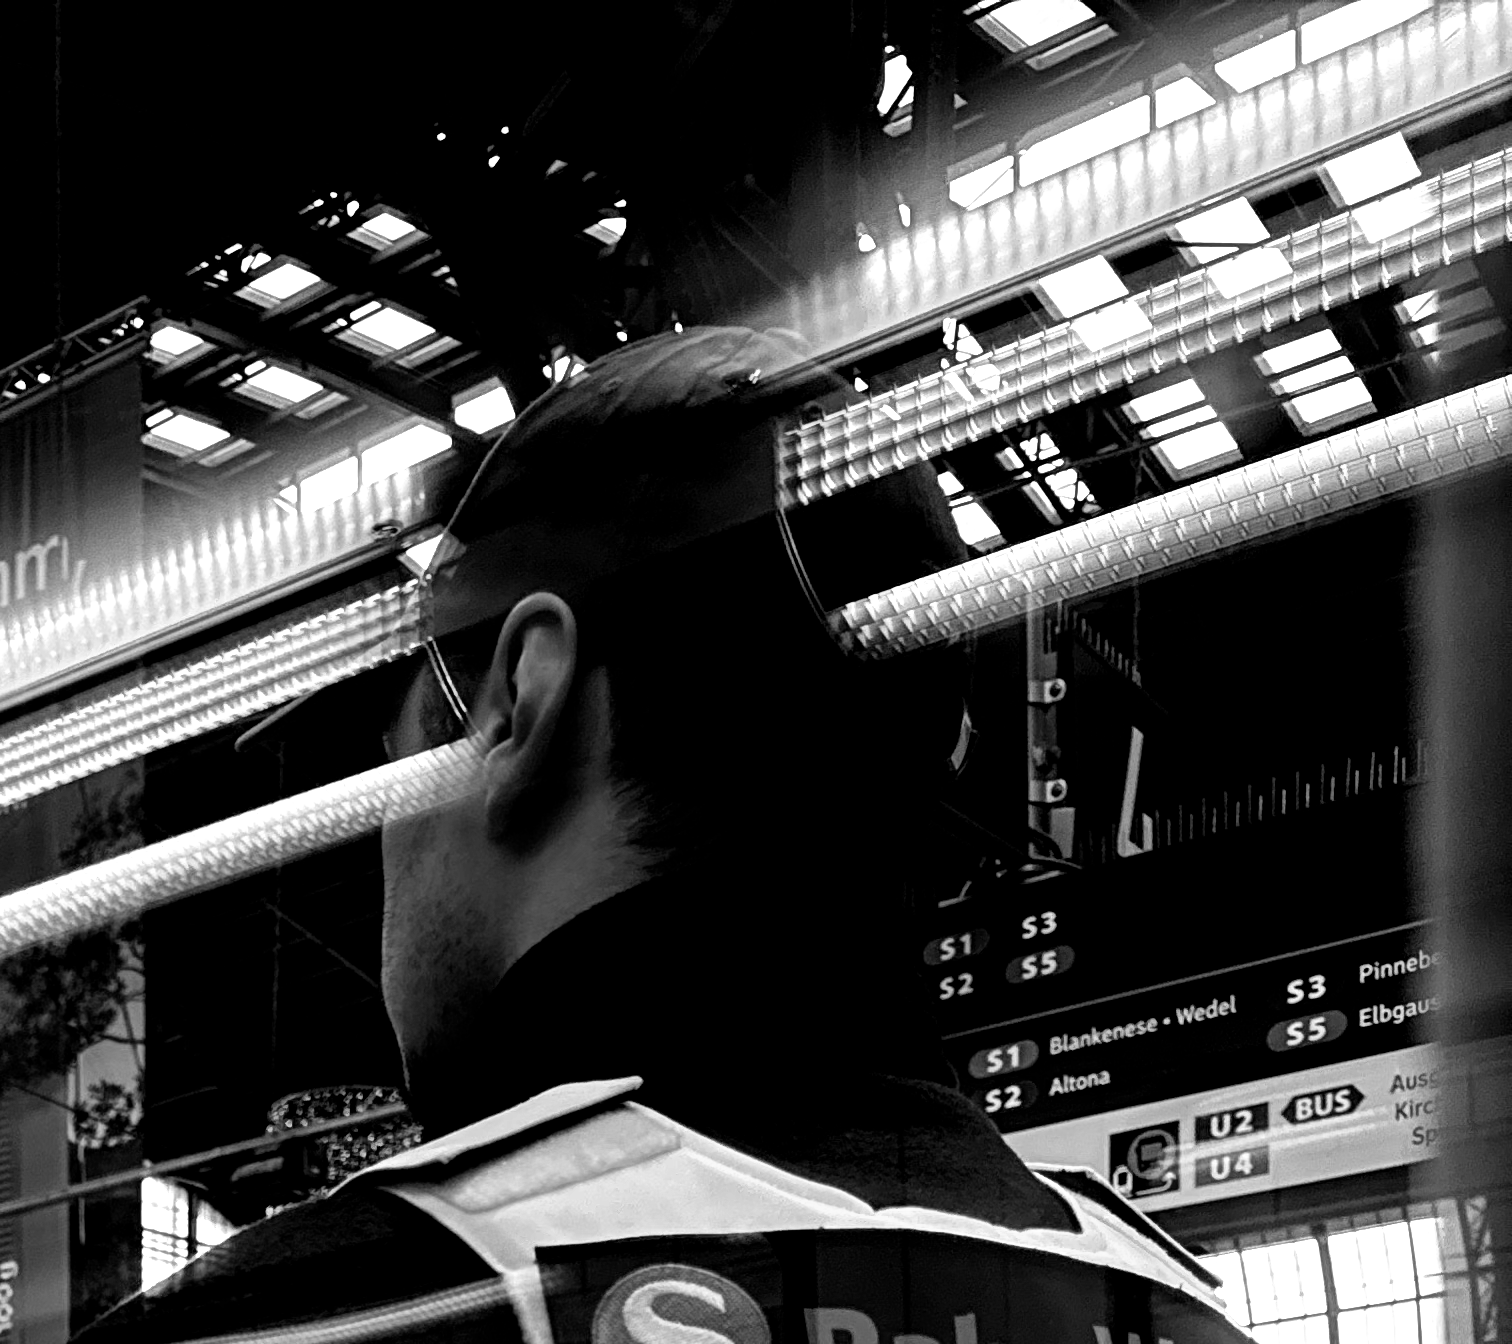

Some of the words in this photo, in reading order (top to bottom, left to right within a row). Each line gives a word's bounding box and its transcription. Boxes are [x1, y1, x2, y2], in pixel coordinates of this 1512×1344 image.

[939, 932, 973, 962] S1
[1021, 910, 1058, 940] S3
[939, 971, 975, 1002] S2
[1021, 949, 1058, 980] S5
[1286, 974, 1327, 1005] S3
[986, 1045, 1020, 1074] S1
[1049, 1017, 1158, 1057] Blankenese
[1175, 994, 1237, 1026] Wedel
[1286, 1015, 1327, 1047] S5
[985, 1085, 1022, 1113] S2
[1048, 1070, 1111, 1098] Altona
[1209, 1111, 1255, 1139] U2
[1294, 1090, 1352, 1121] BUS
[1209, 1152, 1254, 1180] U4
